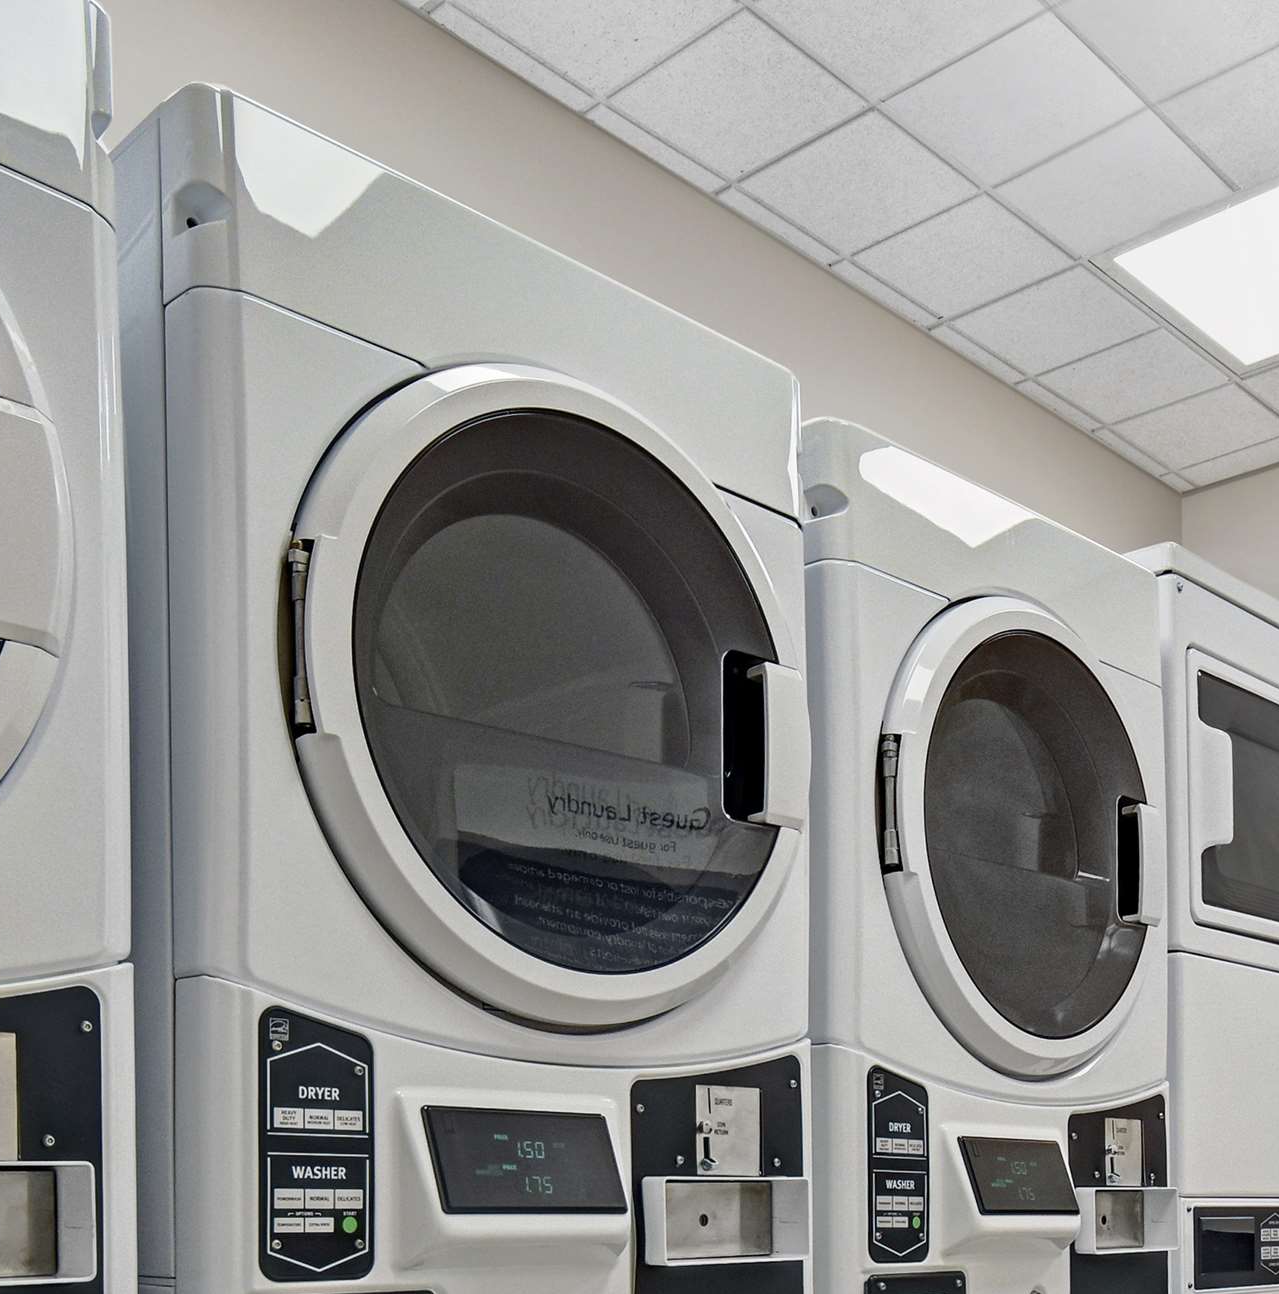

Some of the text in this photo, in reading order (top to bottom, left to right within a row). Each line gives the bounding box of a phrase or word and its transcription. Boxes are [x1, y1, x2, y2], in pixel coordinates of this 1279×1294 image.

[298, 1085, 340, 1101] DRYER
[888, 1121, 912, 1133] DRYER
[292, 1165, 347, 1180] WASHER
[885, 1179, 916, 1190] WASHER
